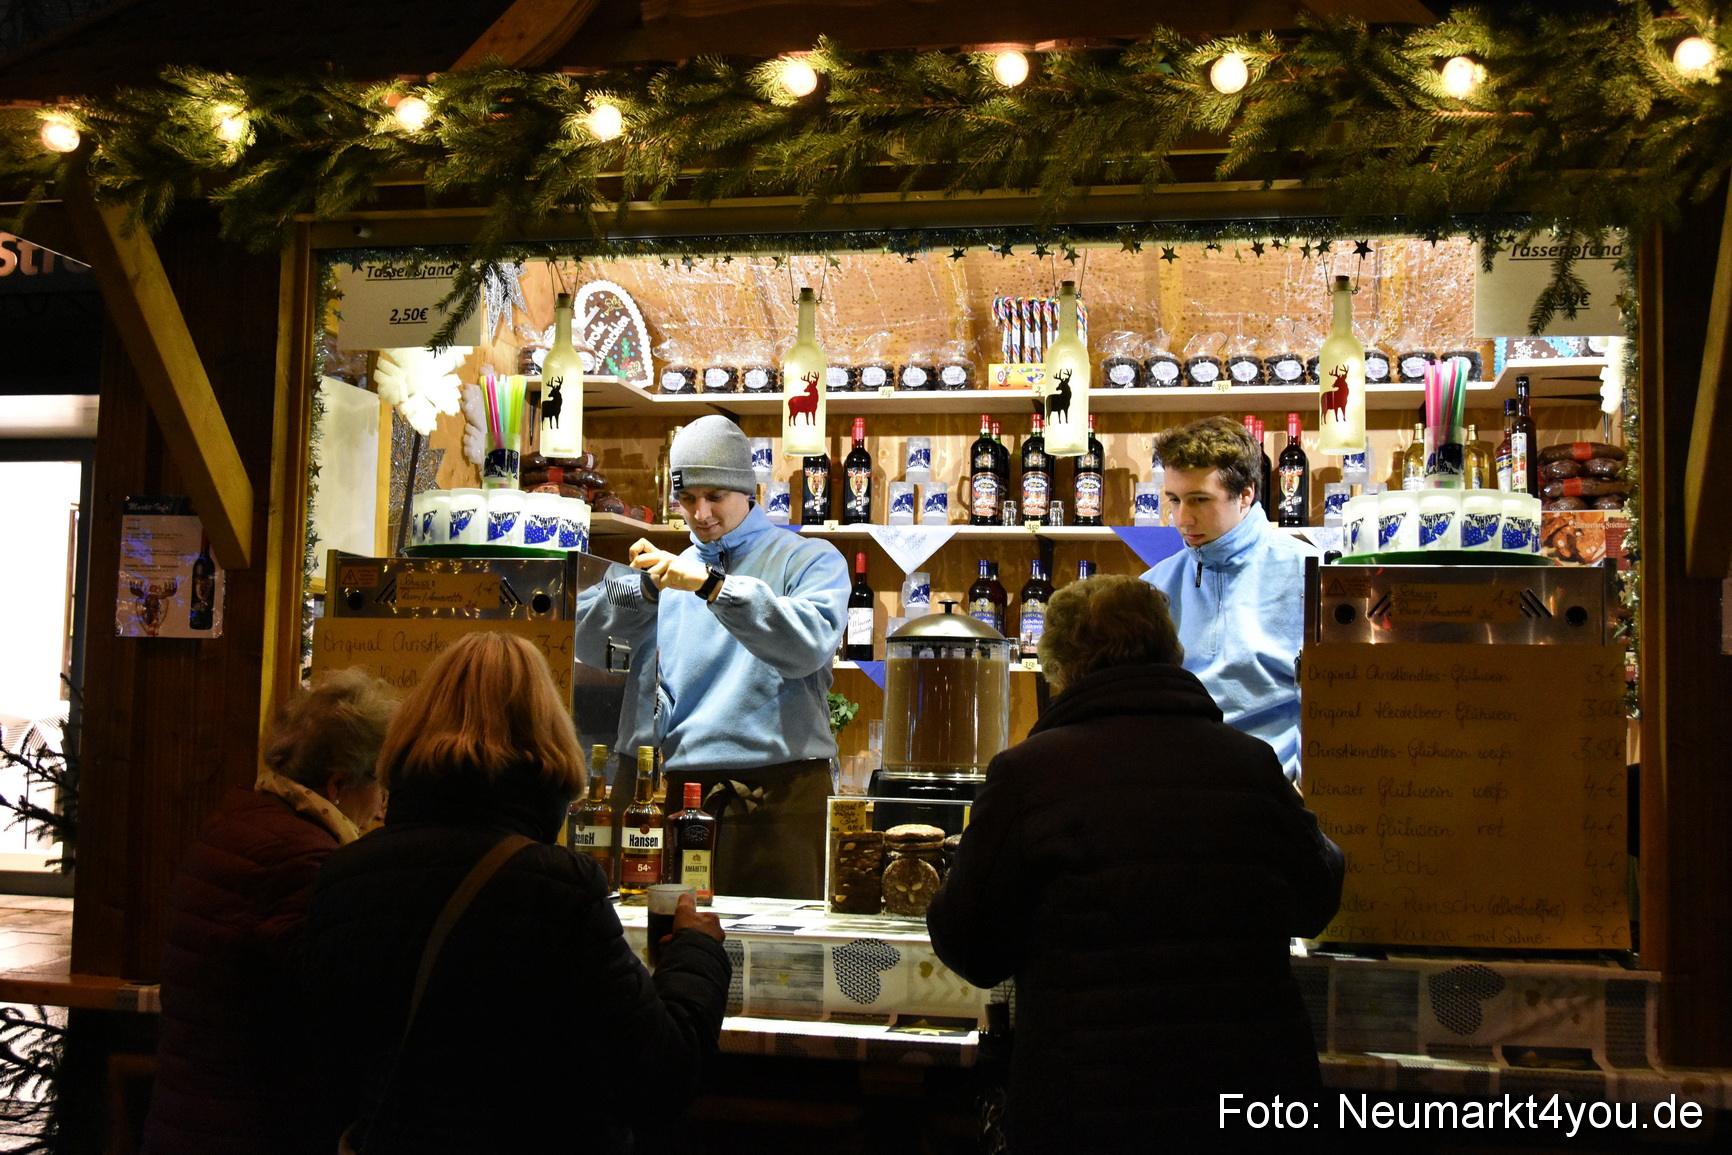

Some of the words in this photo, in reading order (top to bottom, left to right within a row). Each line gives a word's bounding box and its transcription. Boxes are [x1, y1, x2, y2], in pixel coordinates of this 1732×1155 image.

[389, 307, 429, 324] 2,50€
[1308, 663, 1358, 688] Original
[1308, 701, 1363, 728] Original
[1310, 776, 1365, 797] Winzer
[1476, 816, 1507, 838] rot
[629, 833, 659, 848] Hansen
[684, 865, 708, 873] AMARETTO
[1390, 918, 1458, 942] Kakao
